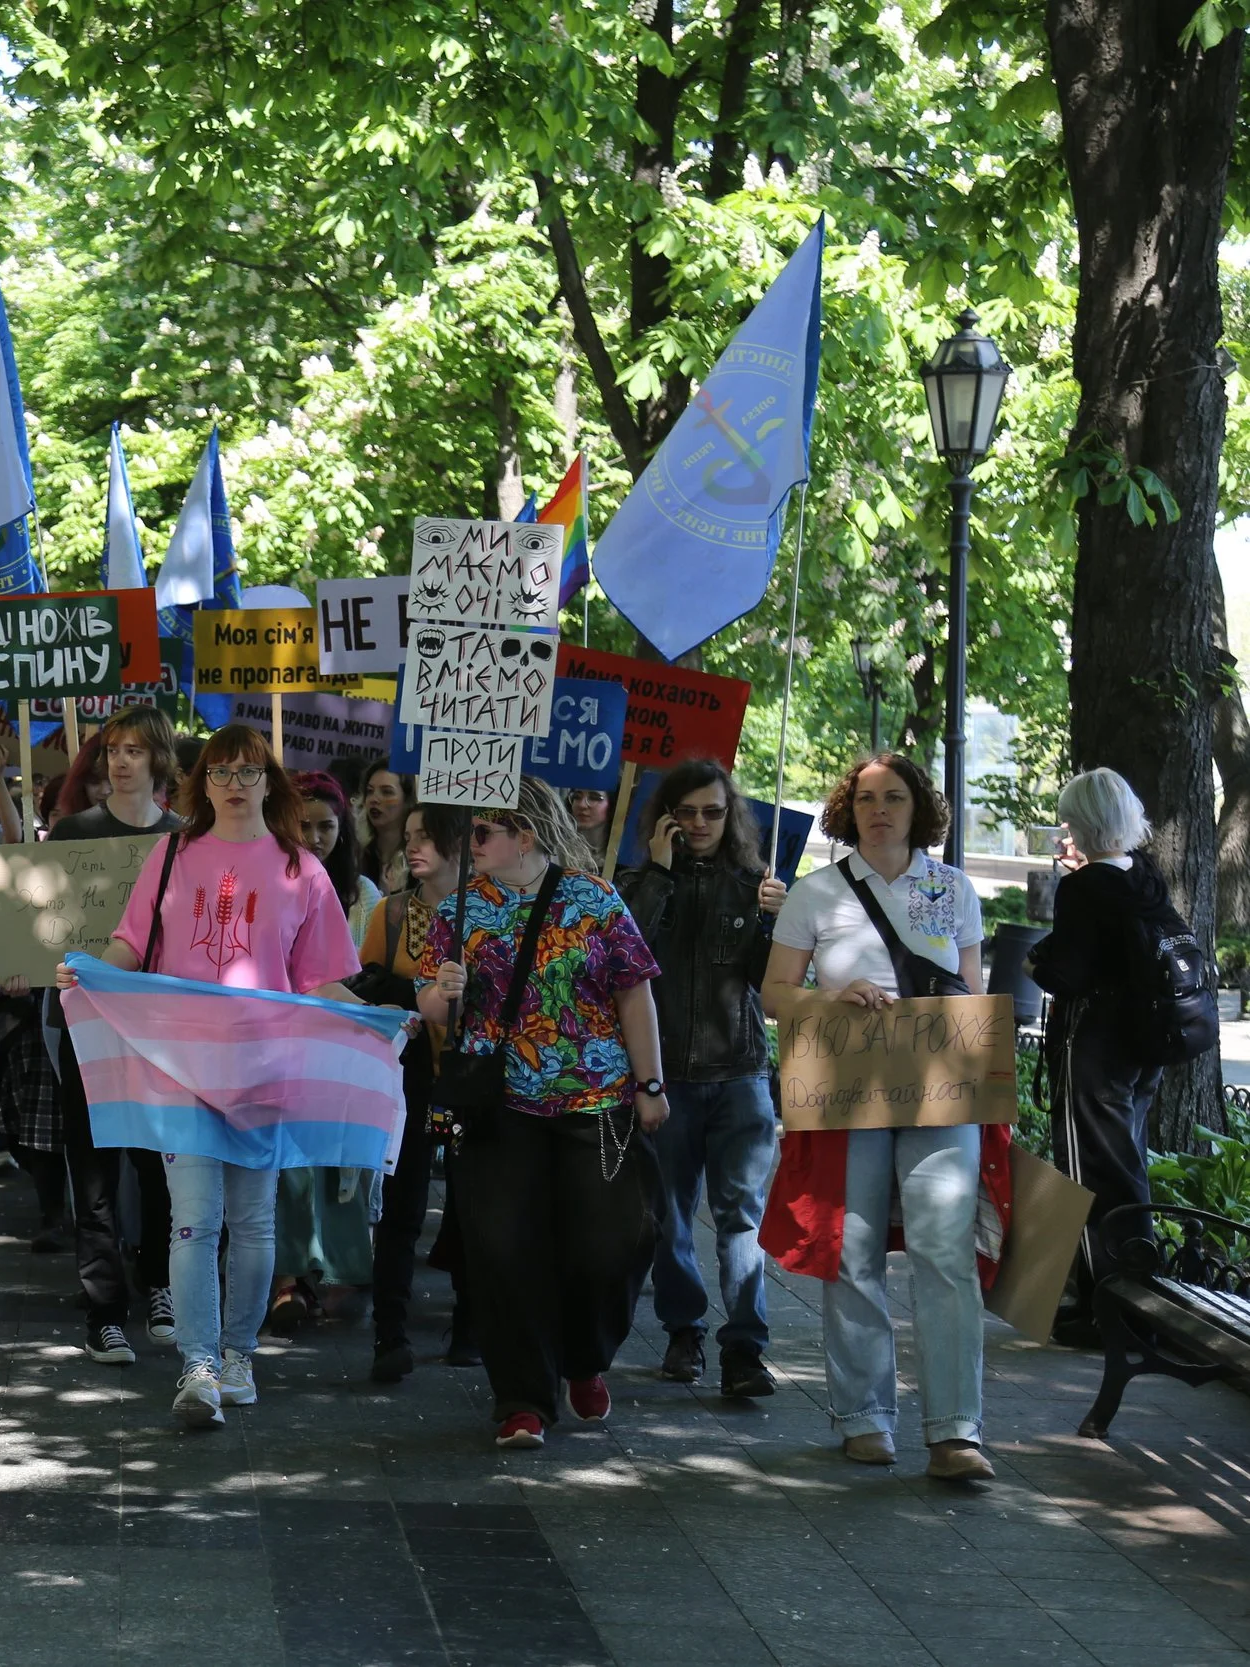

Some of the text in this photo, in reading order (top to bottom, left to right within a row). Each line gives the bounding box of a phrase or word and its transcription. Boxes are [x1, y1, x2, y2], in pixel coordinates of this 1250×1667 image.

[457, 524, 514, 557] МИ
[417, 552, 551, 588] МАЄМО
[19, 605, 113, 647] НОЖІВ
[214, 623, 257, 646] Моя
[264, 621, 314, 645] сім'я
[321, 597, 376, 652] НЕ
[448, 631, 500, 665] ТА
[198, 667, 222, 685] не
[629, 677, 721, 711] кохають
[235, 703, 244, 718] Я
[323, 716, 339, 733] НА
[342, 719, 385, 740] ЖИТТЯ
[420, 692, 540, 733] ЧИТАТИ
[282, 736, 315, 753] РАВО
[318, 739, 333, 756] НА
[428, 738, 516, 773] ПРОТИ
